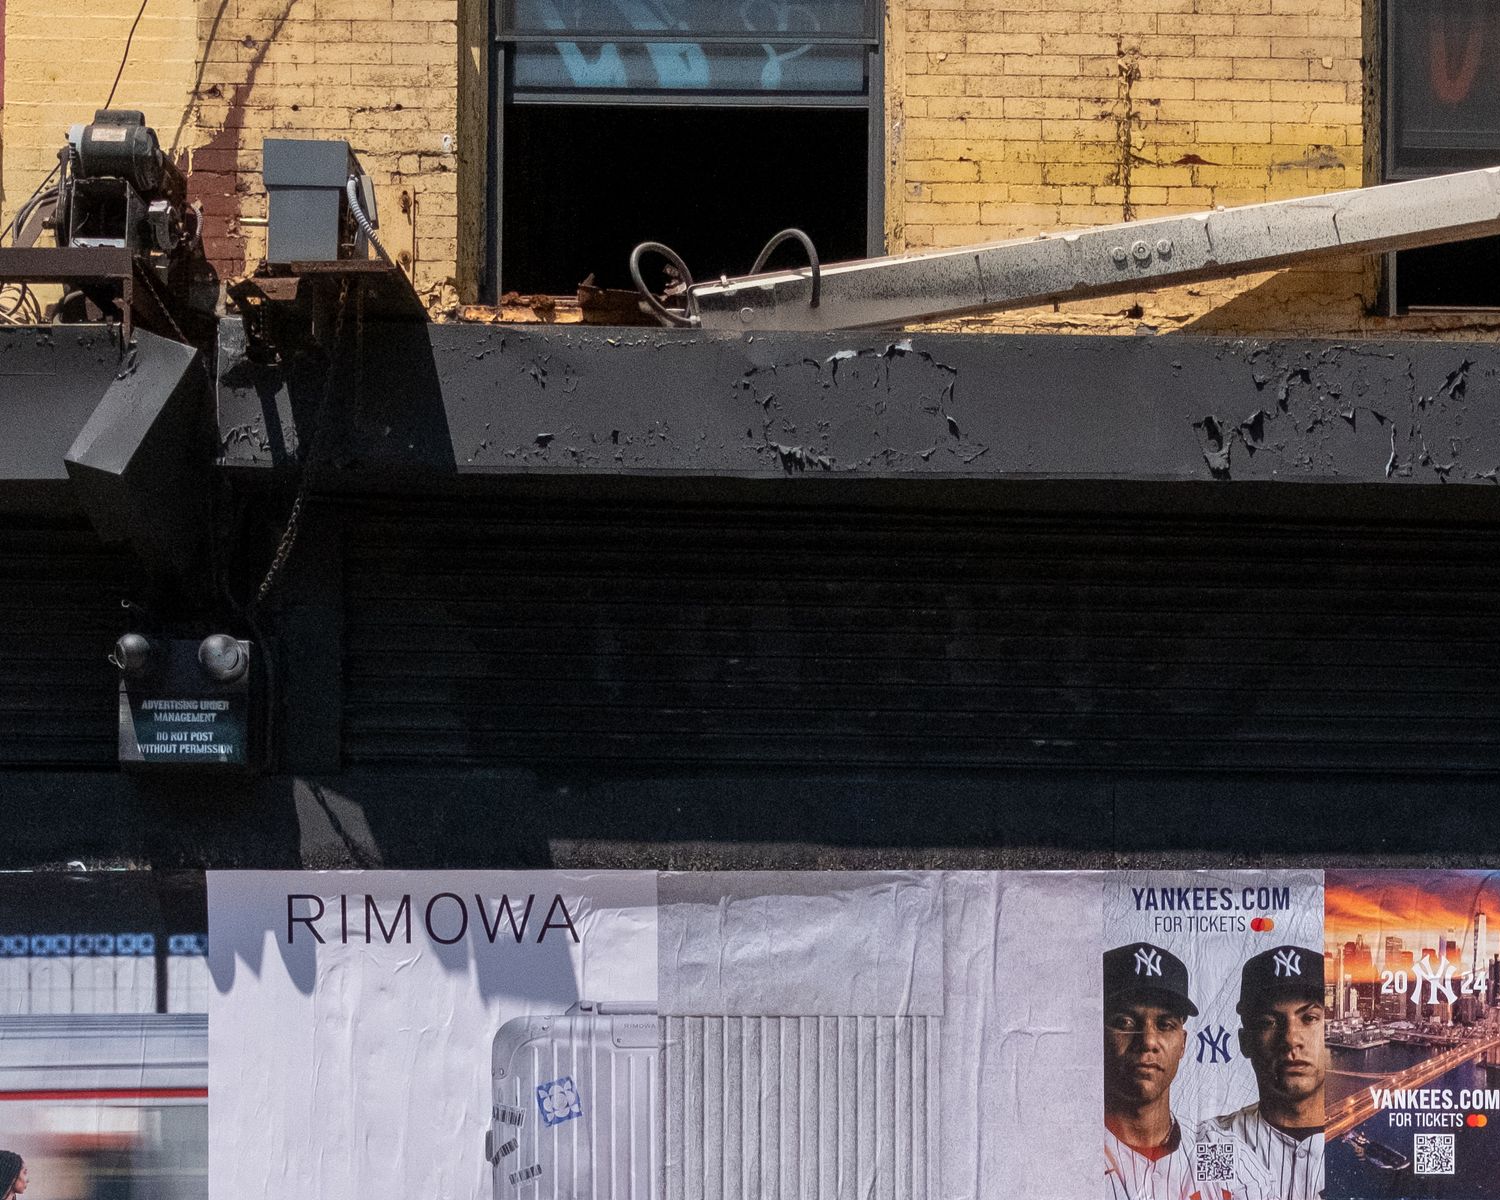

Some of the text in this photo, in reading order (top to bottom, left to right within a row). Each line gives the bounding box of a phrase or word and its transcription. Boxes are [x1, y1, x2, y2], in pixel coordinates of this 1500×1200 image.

[142, 700, 229, 710] ADVERTISING UNDER
[154, 713, 217, 723] MANAGEMENT
[156, 732, 214, 741] DO NOT POST
[137, 744, 233, 754] WITHOUT PERMISSION
[1132, 887, 1290, 911] YANKEES.COM
[287, 892, 580, 944] RIMOWA
[1154, 916, 1246, 933] FOR TICKETS
[1134, 947, 1162, 977] NY
[1273, 949, 1301, 977] NY
[1380, 954, 1488, 1005] 20 NY 24
[1196, 1025, 1232, 1064] NY
[1370, 1088, 1500, 1110] YANKEES.COM
[1389, 1112, 1464, 1127] FOR TICKETS
